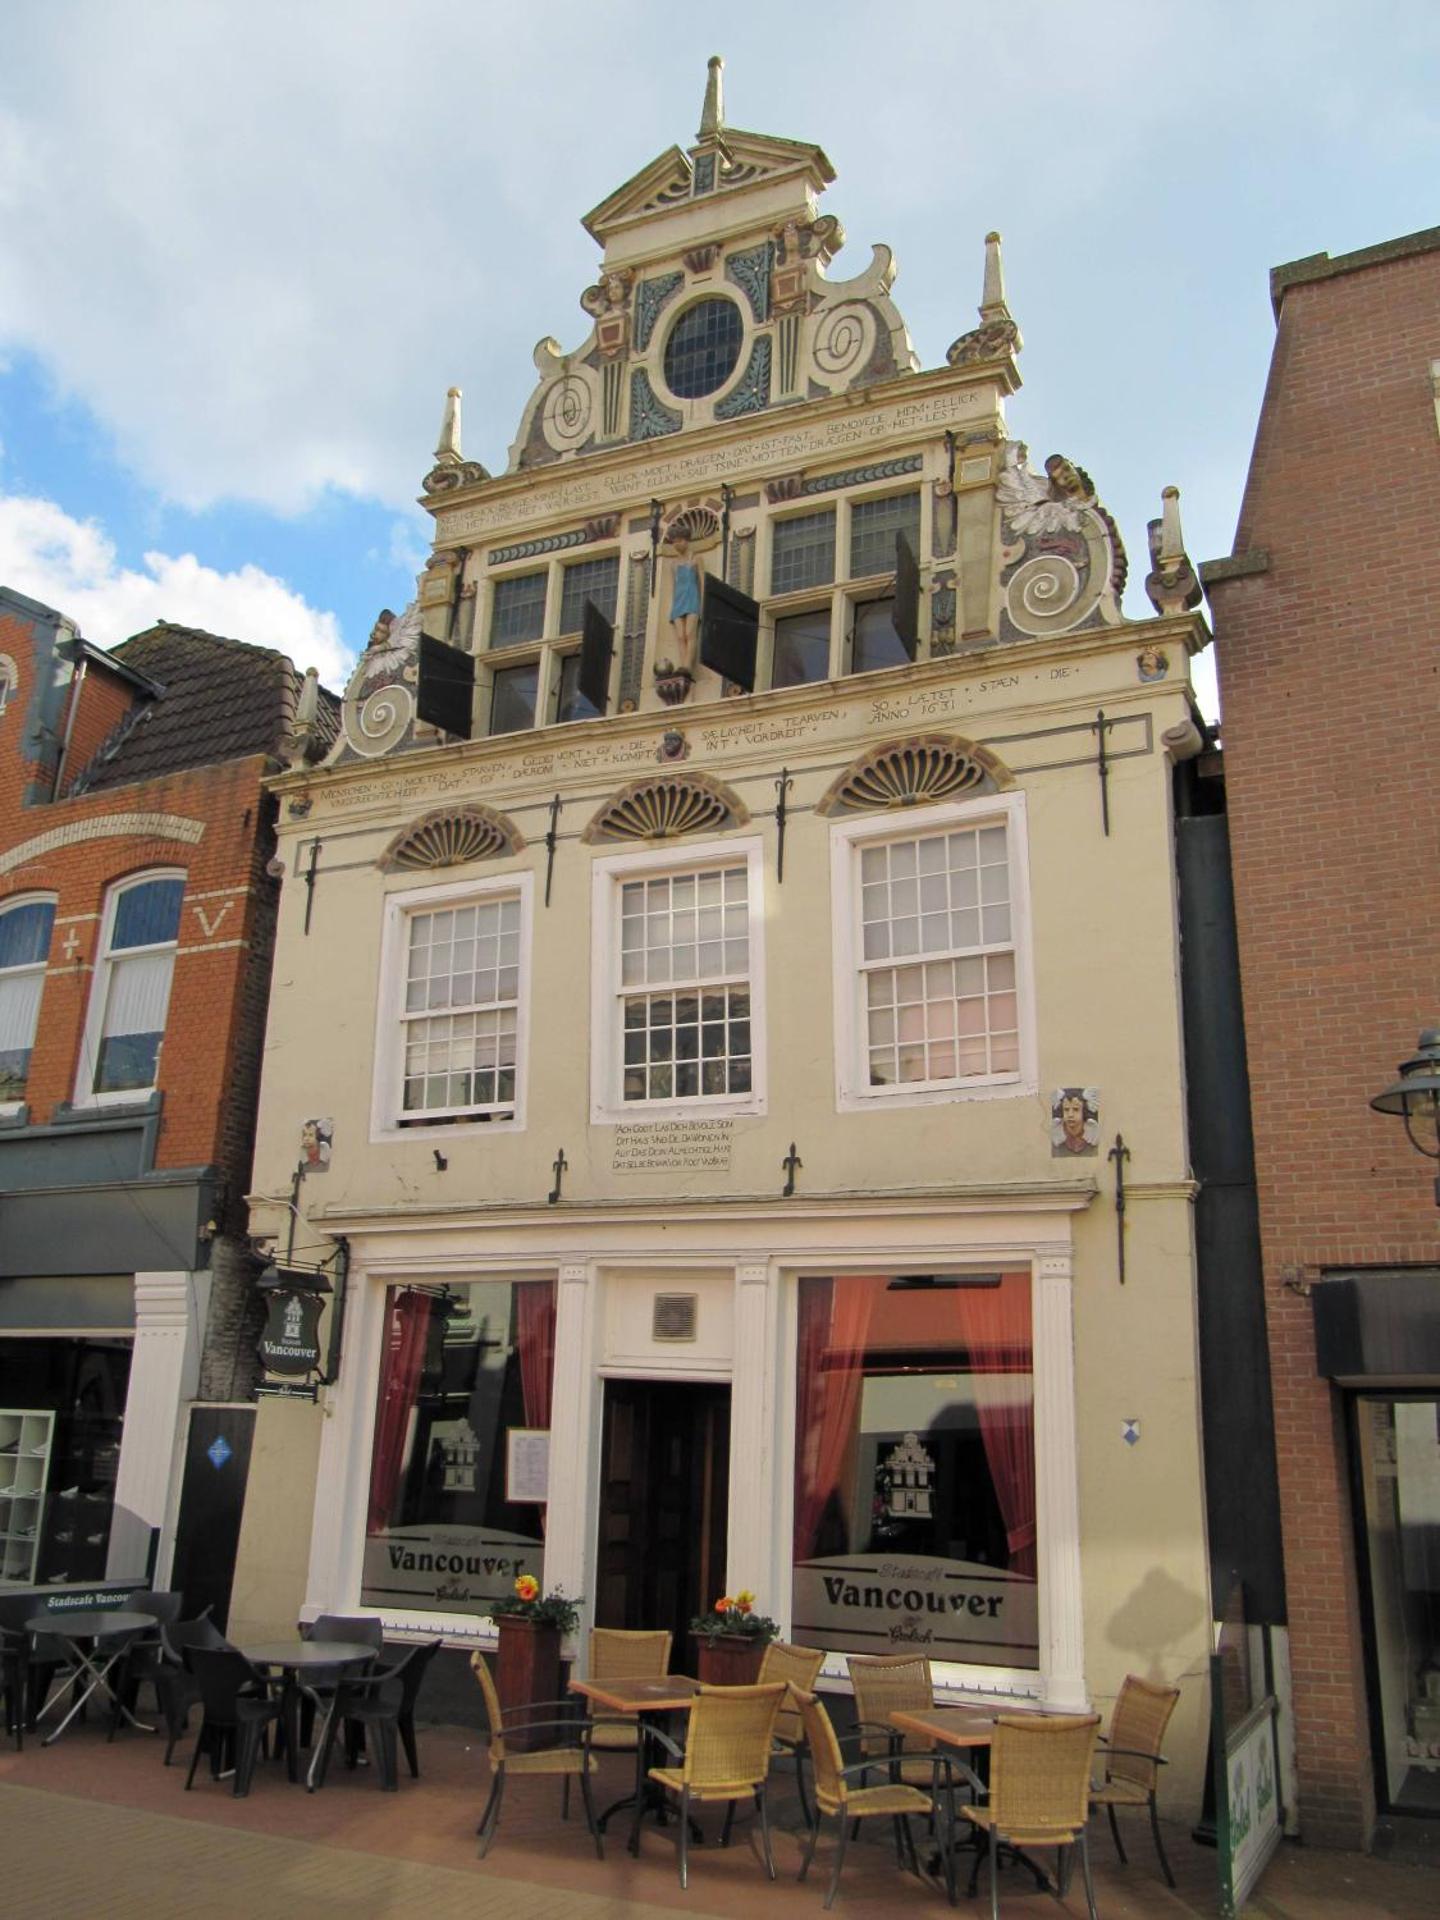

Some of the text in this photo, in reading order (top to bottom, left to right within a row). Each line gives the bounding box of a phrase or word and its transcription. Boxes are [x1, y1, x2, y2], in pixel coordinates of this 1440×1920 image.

[871, 699, 890, 712] SO
[1050, 666, 1071, 679] DIE
[870, 707, 910, 724] ANNO
[264, 1341, 316, 1358] Vancouver
[389, 1546, 525, 1577] Vancouver
[823, 1576, 1004, 1617] Vancouver
